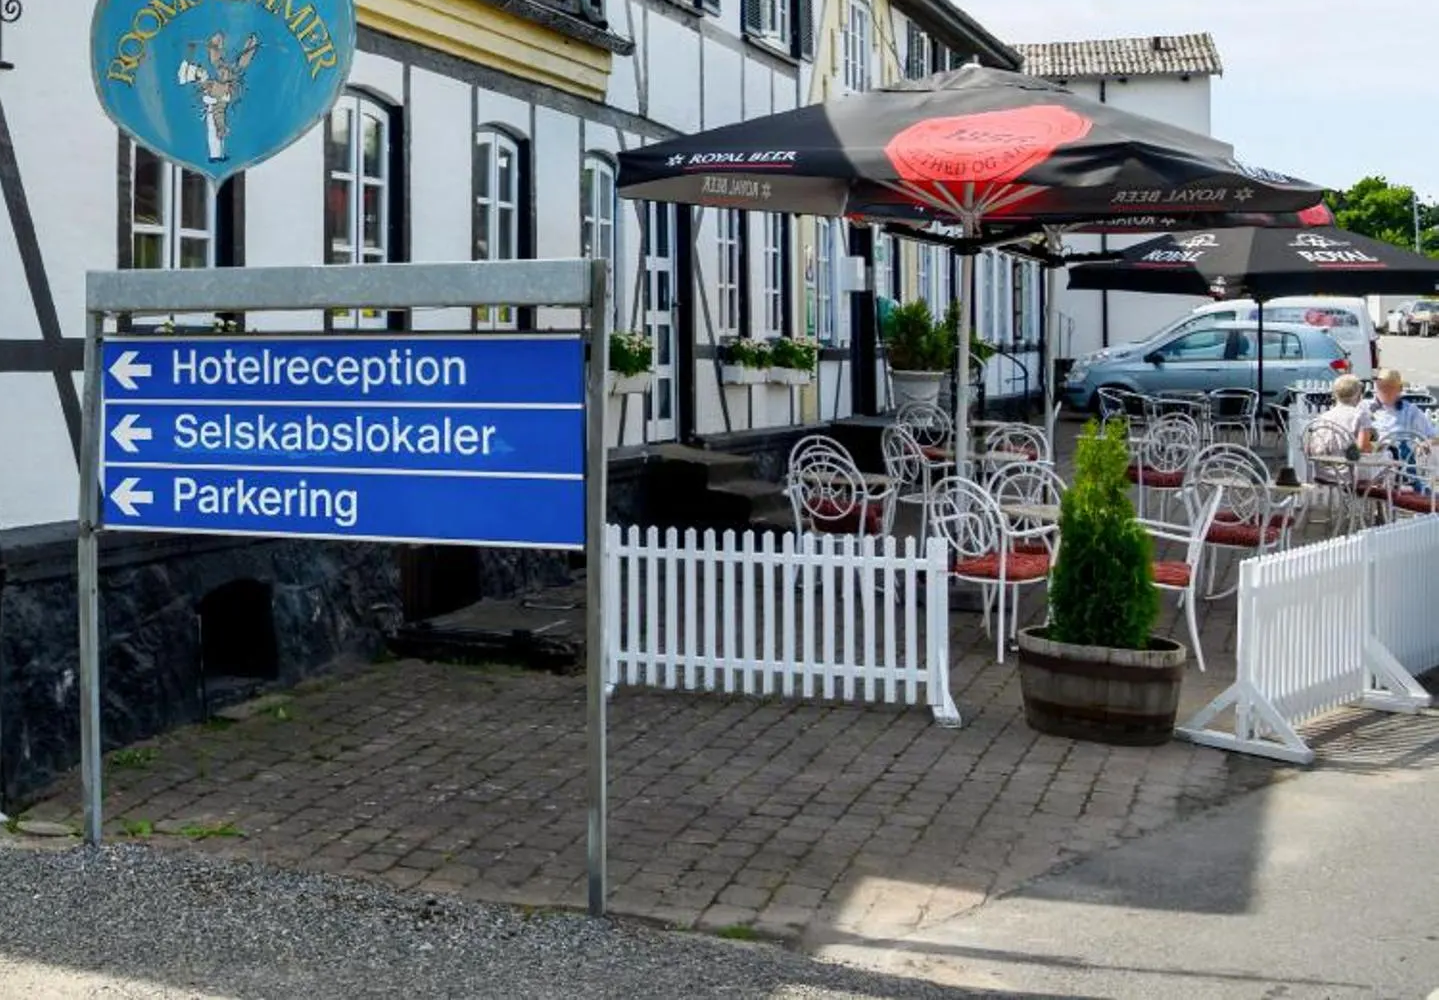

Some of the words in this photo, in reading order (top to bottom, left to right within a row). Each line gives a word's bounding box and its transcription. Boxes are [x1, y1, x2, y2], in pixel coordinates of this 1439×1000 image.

[688, 152, 744, 165] ROYAL
[748, 151, 799, 162] BEER
[1297, 250, 1380, 263] ROYAL
[172, 348, 467, 394] Hotelreception
[173, 413, 497, 456] Selskabslokaler
[172, 476, 359, 528] Parkering
